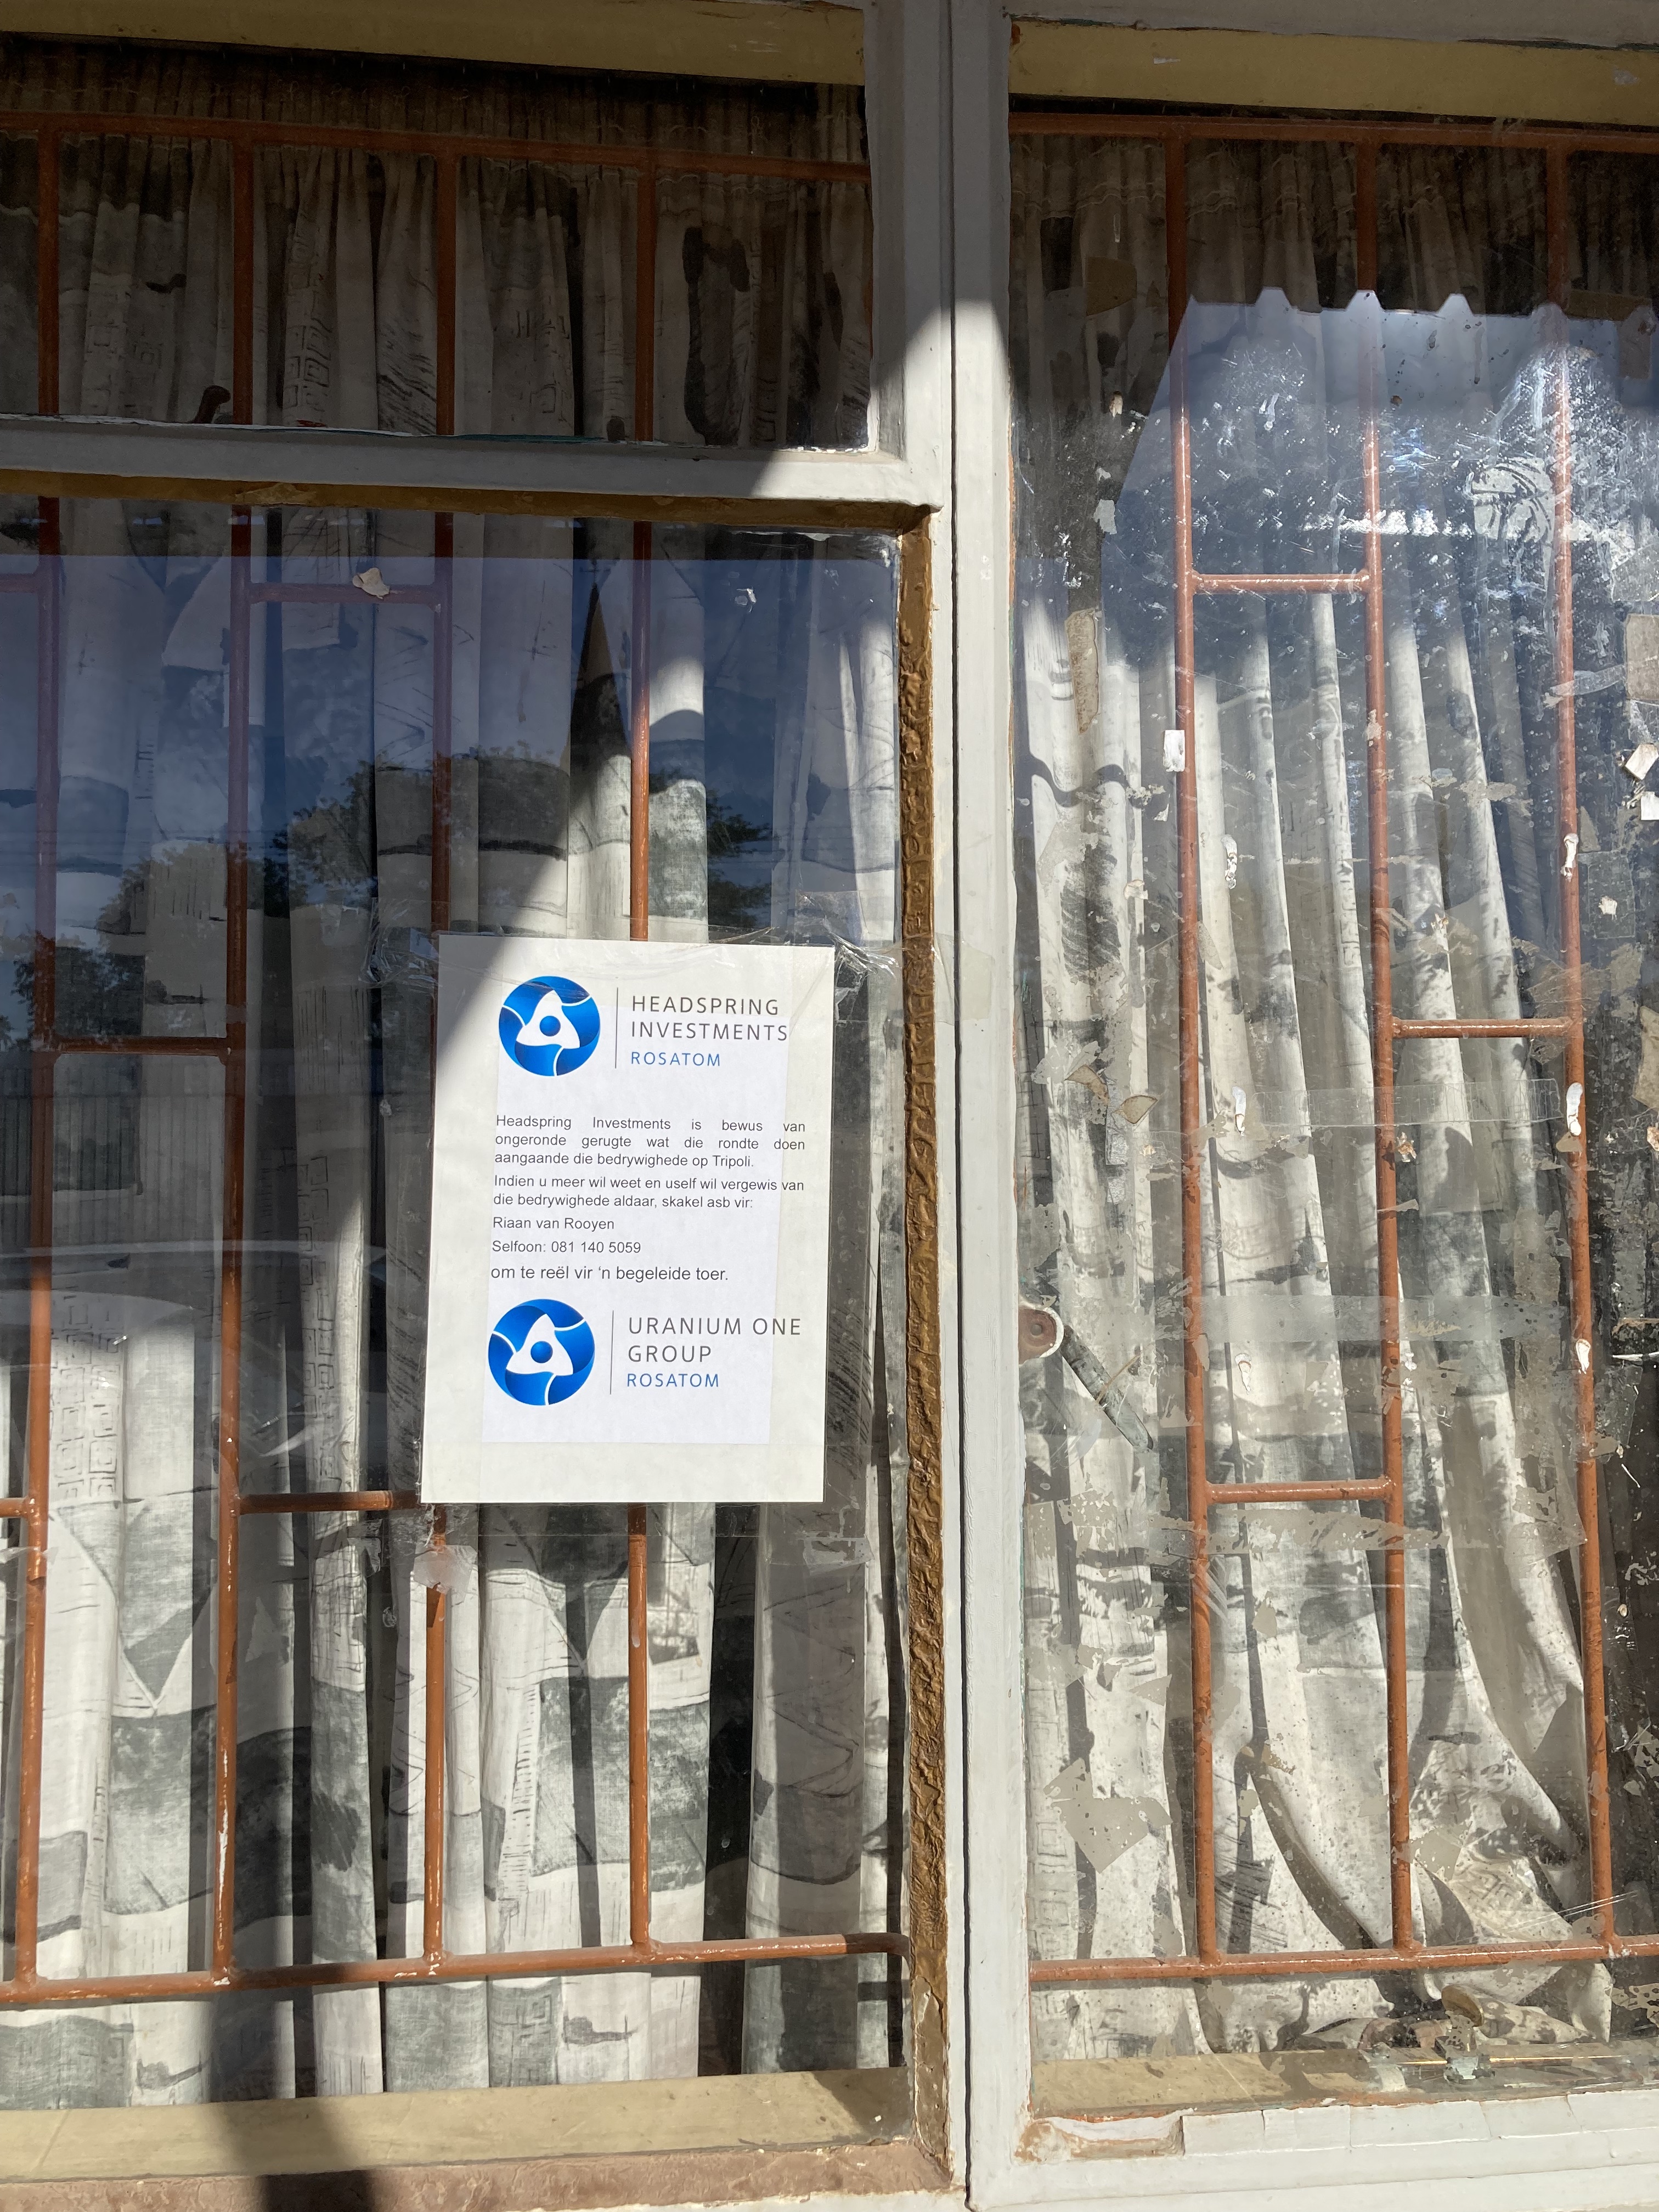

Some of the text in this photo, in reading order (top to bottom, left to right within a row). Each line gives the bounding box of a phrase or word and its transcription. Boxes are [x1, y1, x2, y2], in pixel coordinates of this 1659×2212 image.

[632, 995, 778, 1015] HEADSPRING
[631, 1021, 787, 1041] INVESTMENTS
[631, 1051, 720, 1066] ROSATOM
[496, 1114, 805, 1132] Headspring Investments is bewus van
[495, 1133, 805, 1150] ongeronde gerugte wat die rondte doen
[494, 1152, 754, 1170] aangaande die bedrywighede op Tripoli.
[494, 1174, 804, 1193] Indien u meer wil weet en uself wil vergewis van
[493, 1193, 753, 1209] die bedrywighede aldaar, skakel asb vir:
[493, 1216, 614, 1232] Riaan van Rooyen
[492, 1240, 641, 1254] Selfoon: 081 140 5059
[490, 1268, 515, 1279] om
[520, 1265, 535, 1279] te
[540, 1265, 569, 1279] reël
[574, 1265, 594, 1279] vir
[616, 1266, 691, 1283] begeleide
[696, 1267, 728, 1280] toer.
[629, 1317, 801, 1335] URANIUM ONE
[628, 1345, 712, 1363] GROUP
[627, 1373, 719, 1387] ROSATOM
